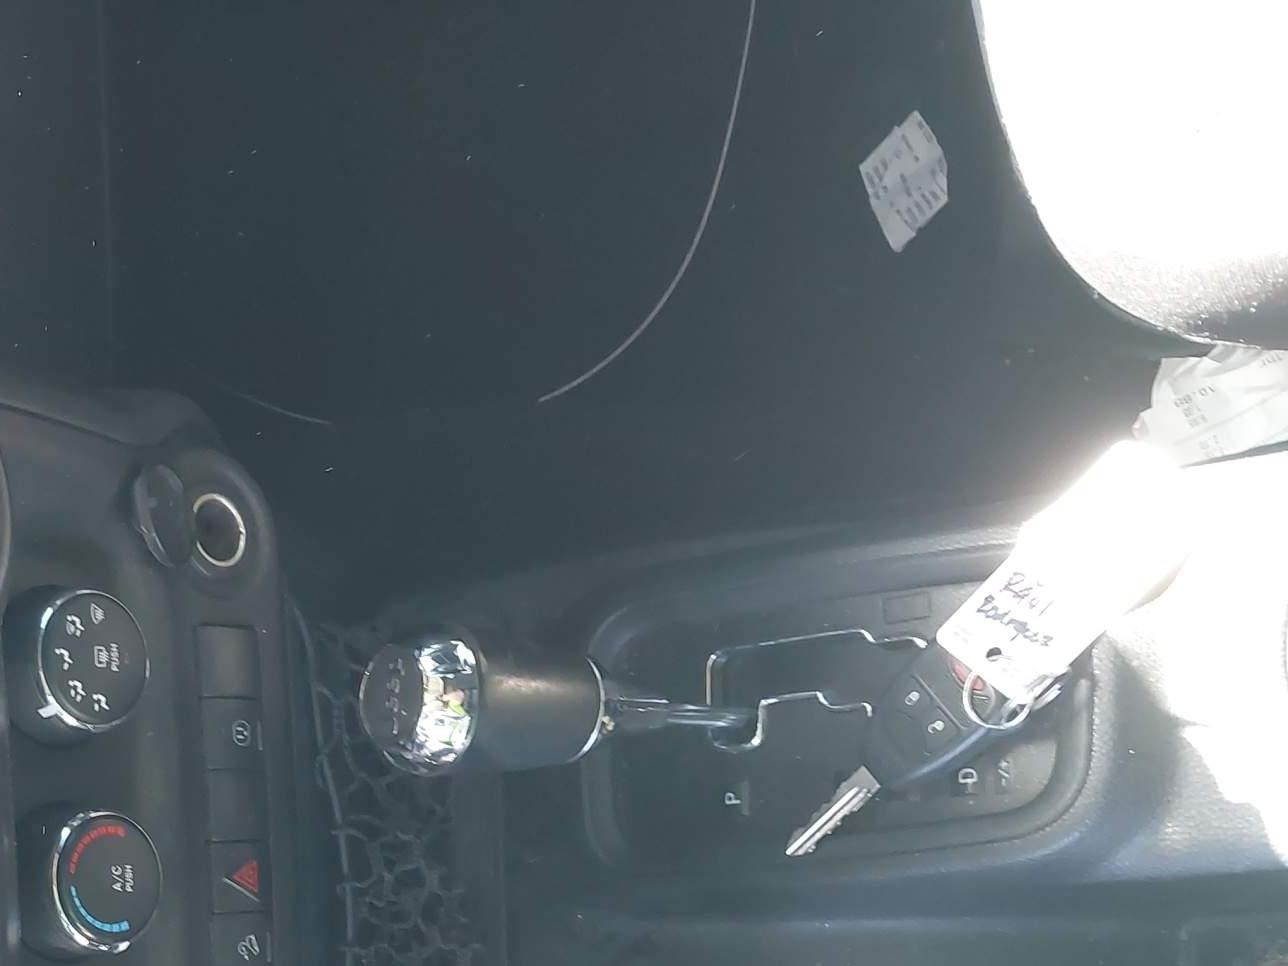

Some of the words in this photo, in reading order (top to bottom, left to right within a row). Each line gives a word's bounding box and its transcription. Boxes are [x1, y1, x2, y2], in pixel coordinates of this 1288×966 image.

[108, 644, 119, 671] PUSH
[959, 769, 977, 784] D
[725, 793, 740, 804] P
[112, 866, 124, 891] A/C
[123, 865, 133, 891] PUSH
